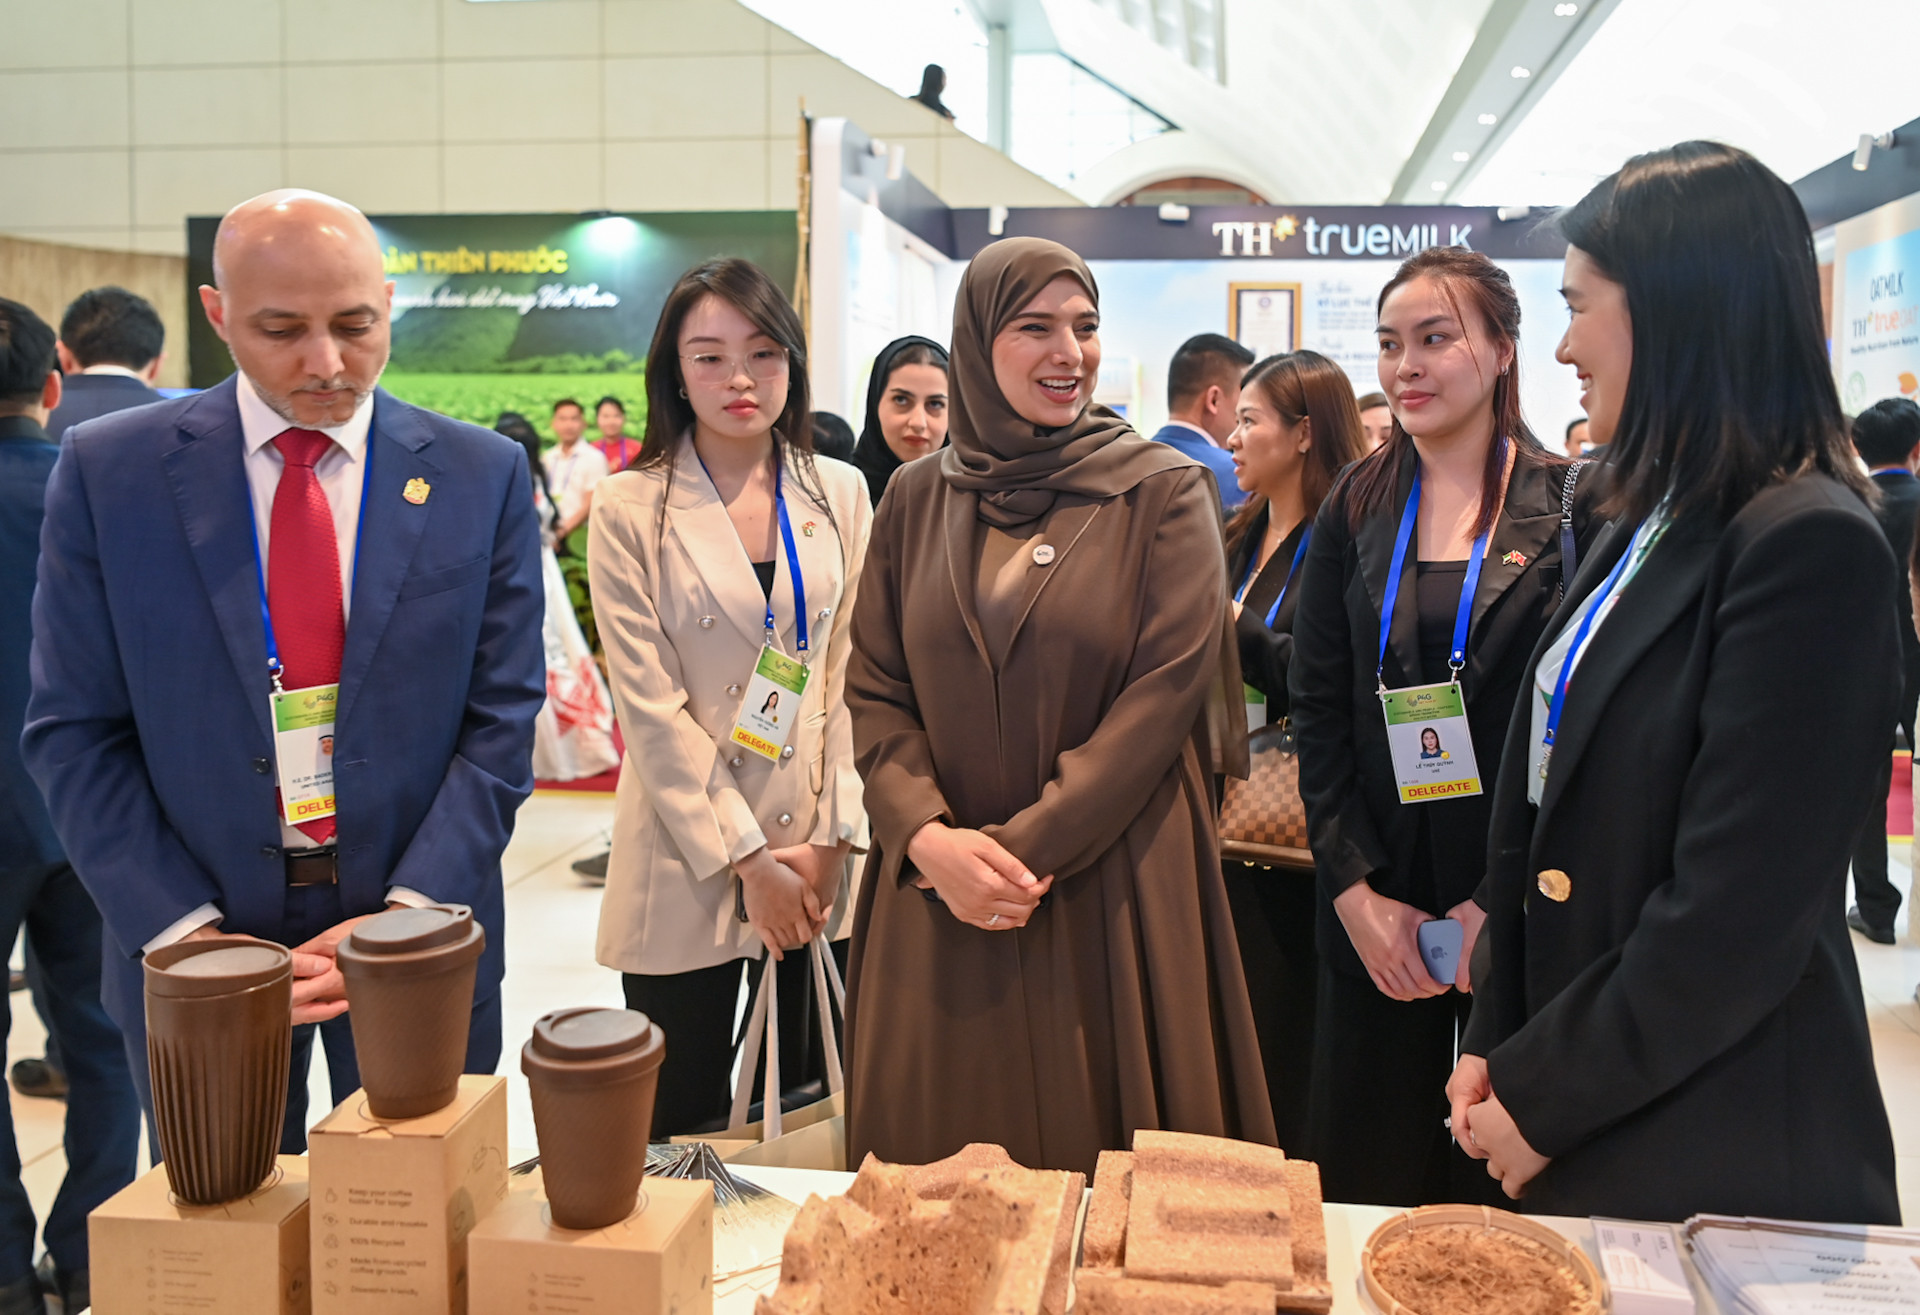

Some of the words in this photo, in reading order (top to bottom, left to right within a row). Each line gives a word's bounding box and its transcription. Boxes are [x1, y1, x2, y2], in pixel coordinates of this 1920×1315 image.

[1212, 221, 1274, 256] TH
[737, 731, 776, 756] DELEGATE
[1408, 782, 1472, 798] DELEGATE
[297, 798, 336, 816] DELE
[348, 1188, 368, 1197] Keep
[370, 1190, 386, 1198] your
[388, 1189, 412, 1197] coffee
[349, 1217, 379, 1226] Durable
[381, 1219, 395, 1227] and
[396, 1220, 428, 1228] reusable
[371, 1238, 405, 1247] Recycled
[350, 1257, 371, 1265] Made
[373, 1257, 392, 1265] from
[350, 1266, 374, 1274] coffee
[376, 1268, 407, 1277] grounds
